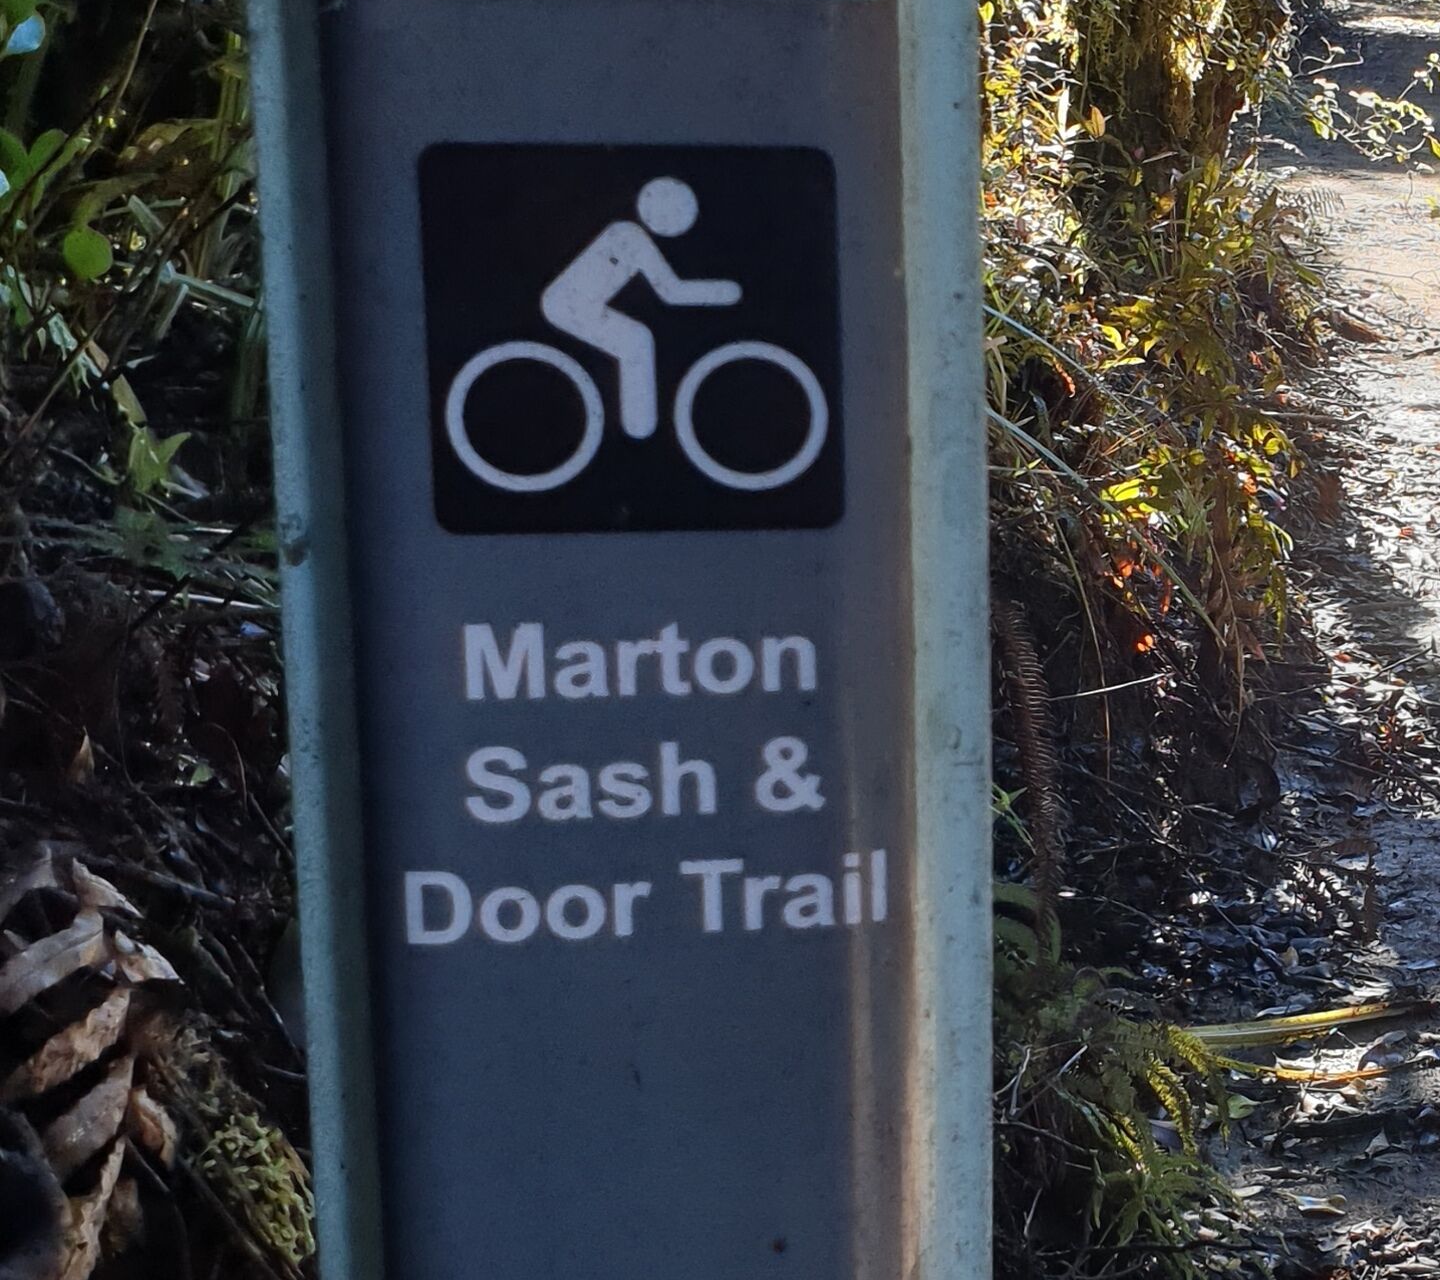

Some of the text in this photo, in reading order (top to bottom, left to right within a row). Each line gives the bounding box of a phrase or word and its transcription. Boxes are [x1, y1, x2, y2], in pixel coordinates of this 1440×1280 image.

[464, 622, 818, 700] Marton
[465, 735, 827, 823] Sash &
[404, 849, 888, 946] Door Trail
